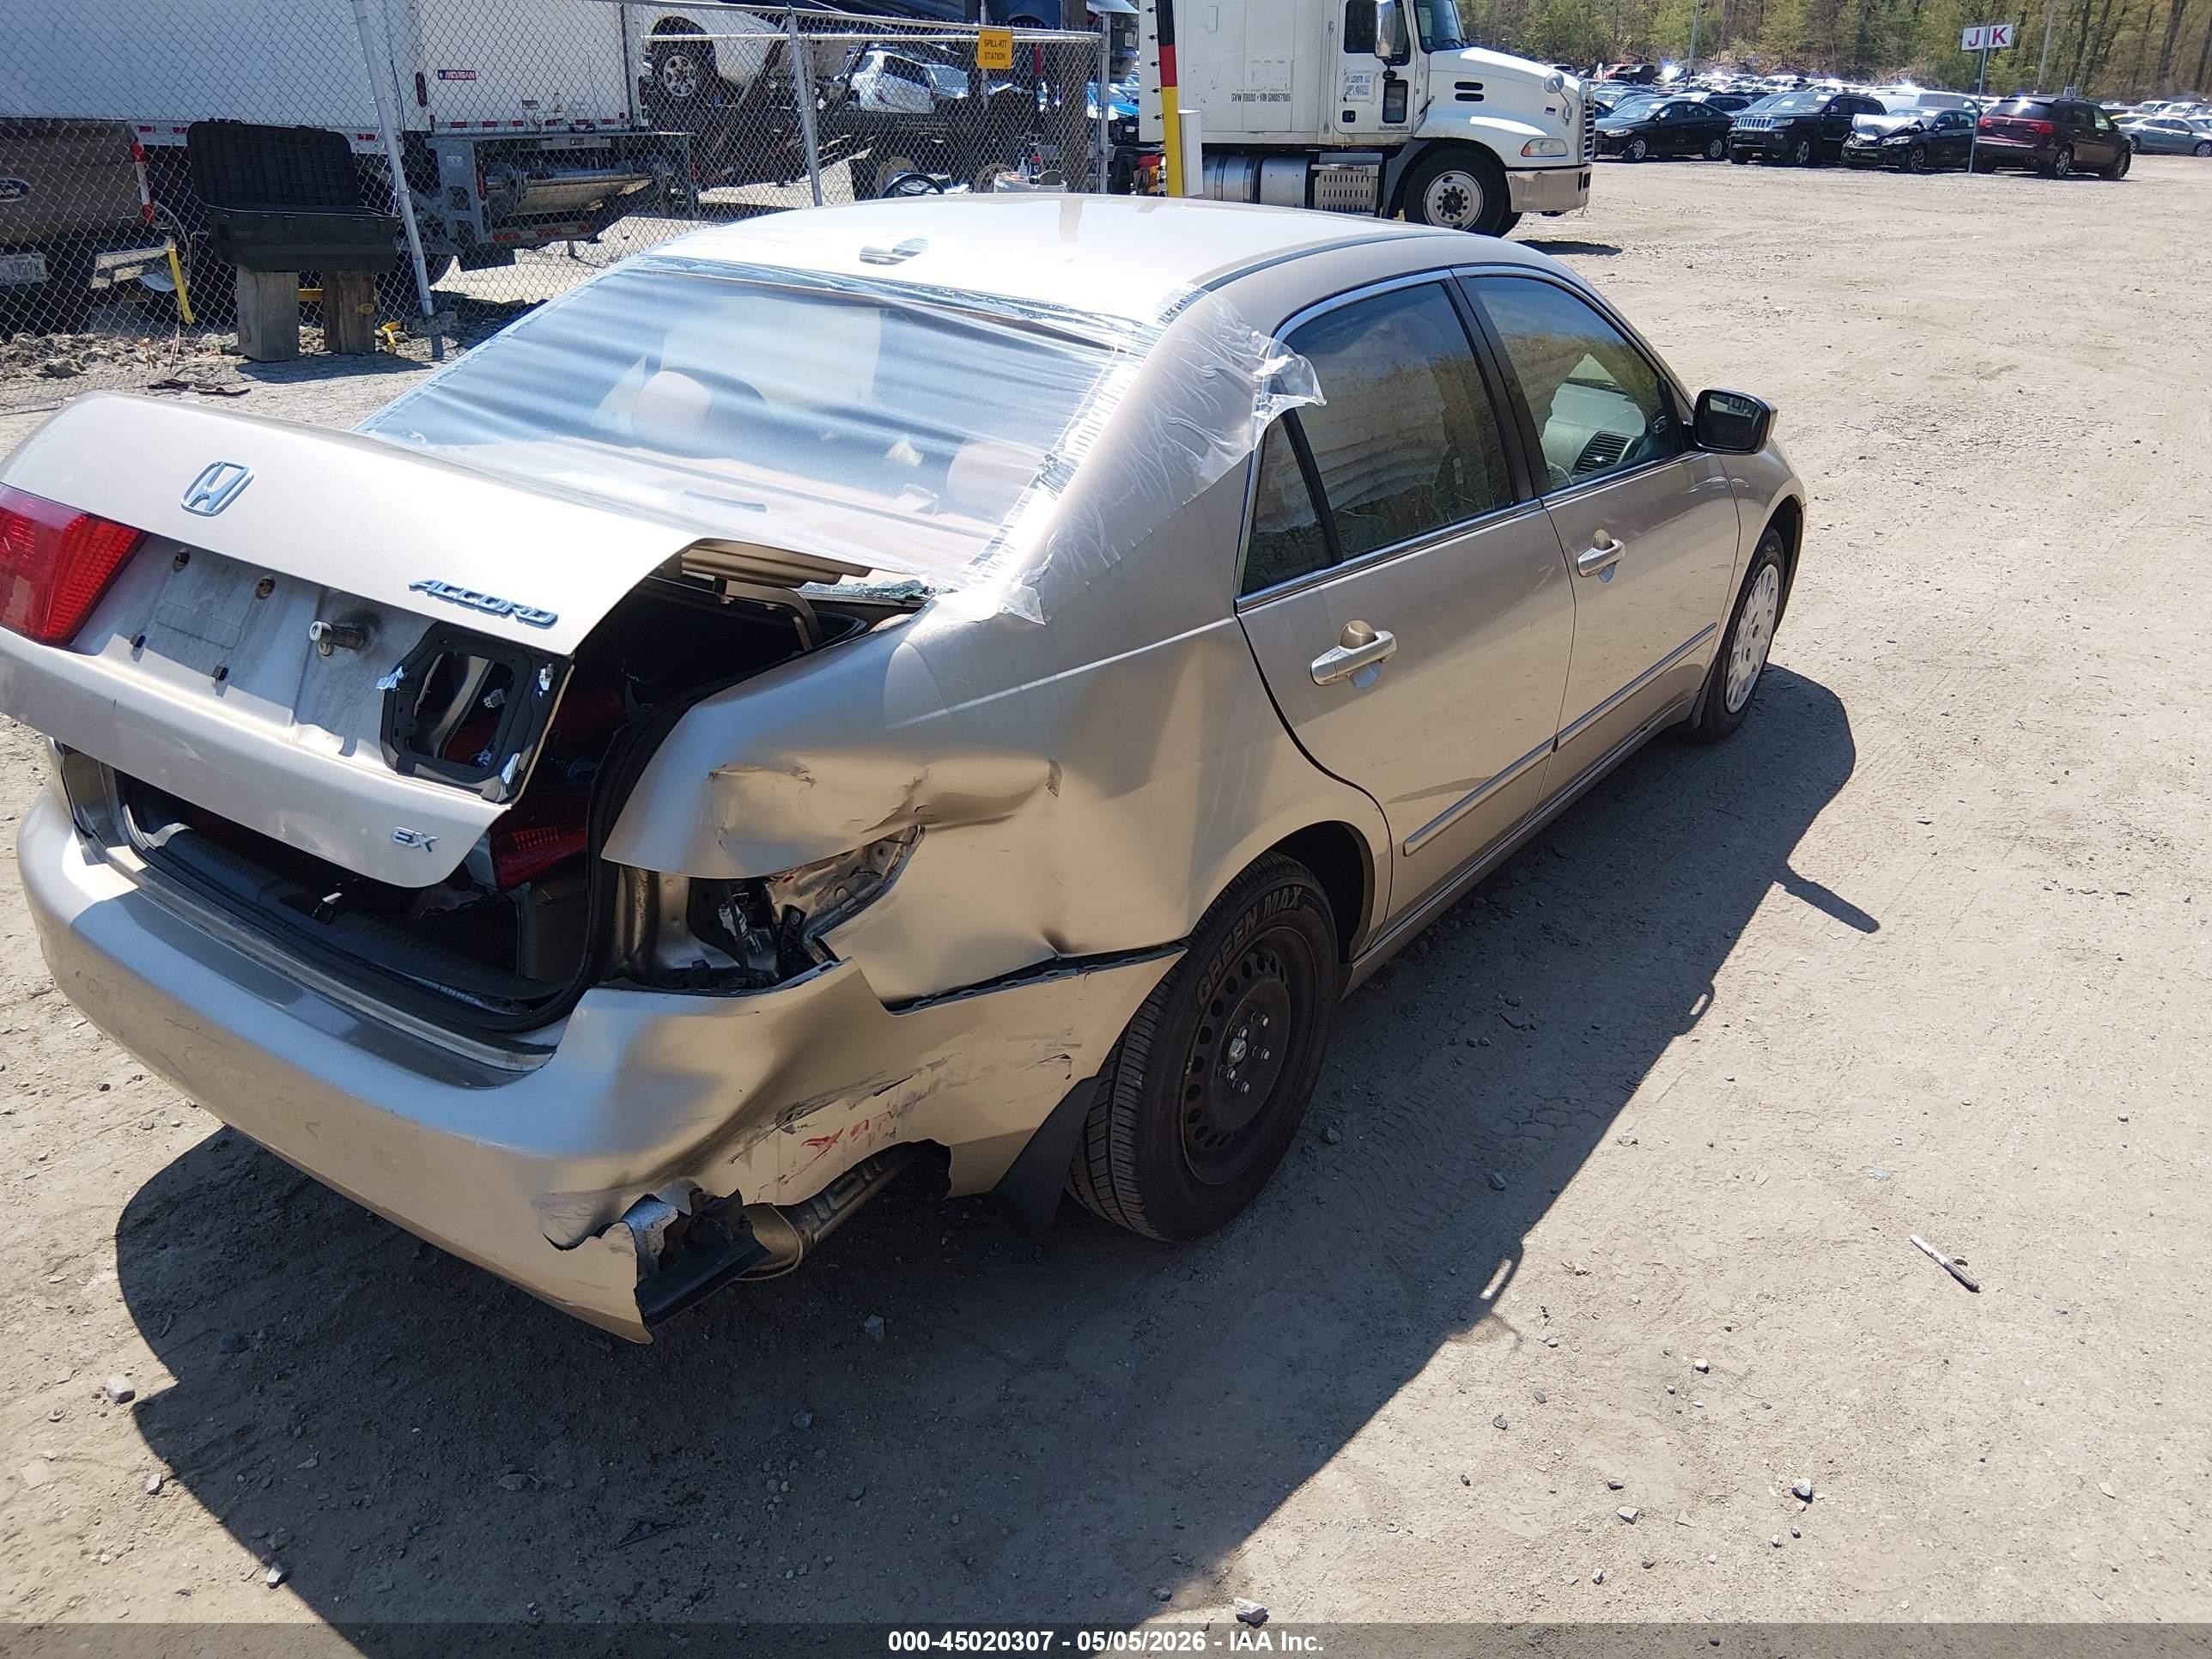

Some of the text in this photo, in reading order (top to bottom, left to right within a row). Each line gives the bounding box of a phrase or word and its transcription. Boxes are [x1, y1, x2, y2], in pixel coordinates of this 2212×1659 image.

[984, 39, 1006, 48] SPILL-KIT
[1968, 27, 2008, 46] J K
[984, 52, 1006, 60] STATION
[1231, 93, 1243, 102] GVW
[1259, 93, 1267, 102] VIN
[2066, 88, 2075, 97] 10
[408, 579, 558, 630] ACCORD
[391, 826, 440, 852] EX
[1196, 885, 1303, 1004] GREEN MAX
